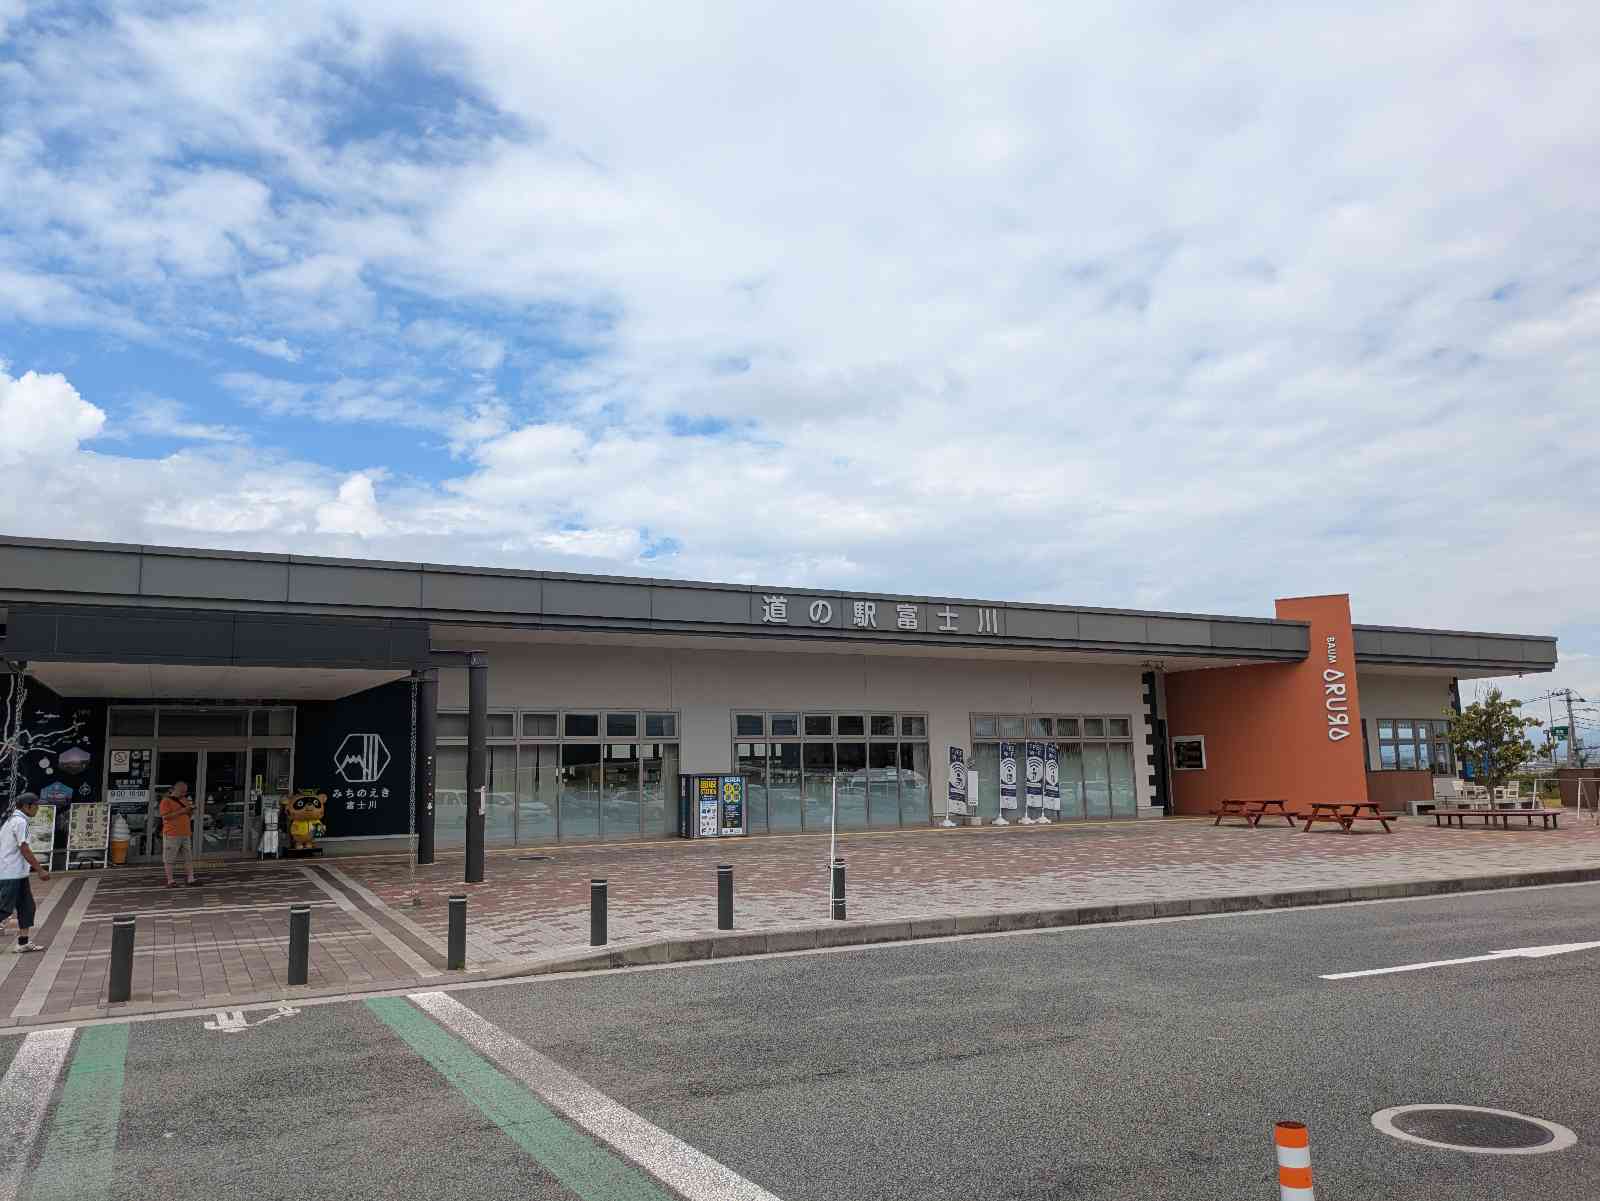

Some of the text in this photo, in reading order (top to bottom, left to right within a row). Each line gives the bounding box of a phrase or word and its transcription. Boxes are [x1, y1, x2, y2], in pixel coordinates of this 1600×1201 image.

[762, 595, 999, 634] 道の駅富士川
[1327, 636, 1337, 663] BAUM
[332, 788, 390, 799] みちのえき
[346, 800, 377, 810] 富士川
